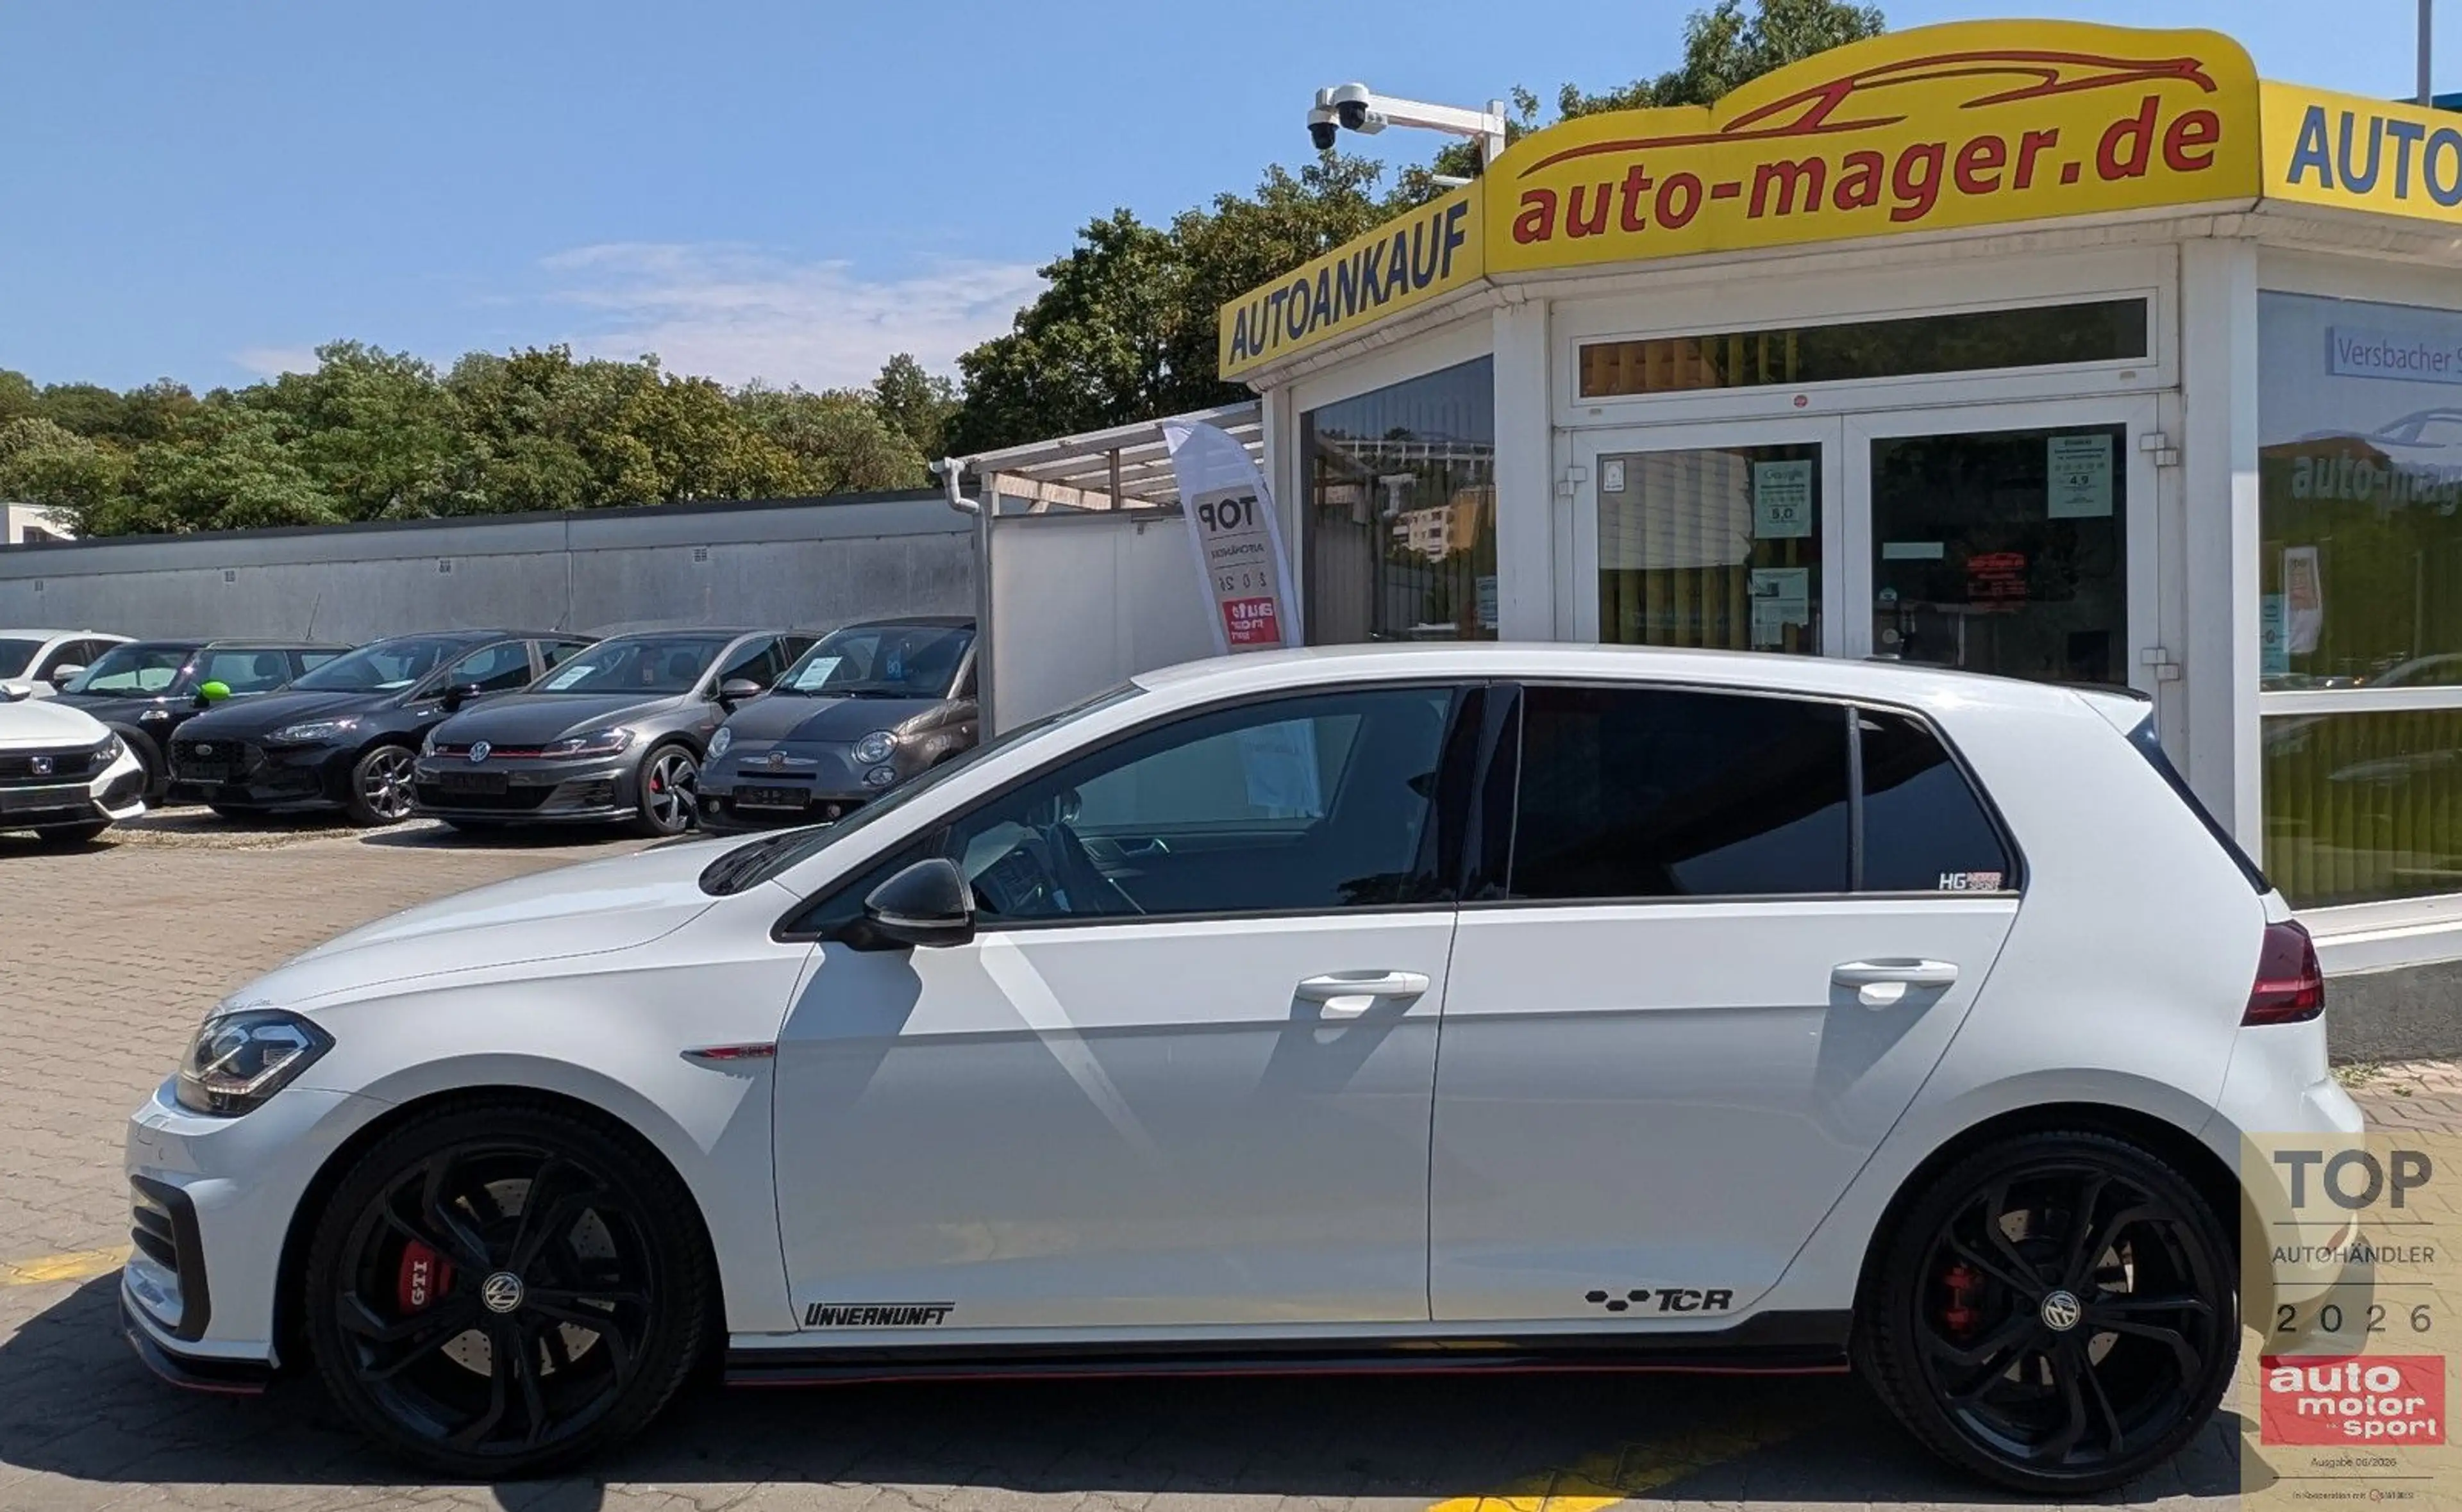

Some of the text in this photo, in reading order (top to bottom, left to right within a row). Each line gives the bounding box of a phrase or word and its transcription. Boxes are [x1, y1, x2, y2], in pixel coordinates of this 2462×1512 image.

[1512, 95, 2221, 244] auto-mager.de
[2286, 104, 2462, 207] AUTO
[1228, 199, 1469, 366] AUTOANKAUF
[2339, 338, 2452, 372] Versbacher
[1939, 872, 1966, 890] HG
[412, 1261, 428, 1305] GTI
[1655, 1288, 1734, 1311] TCR
